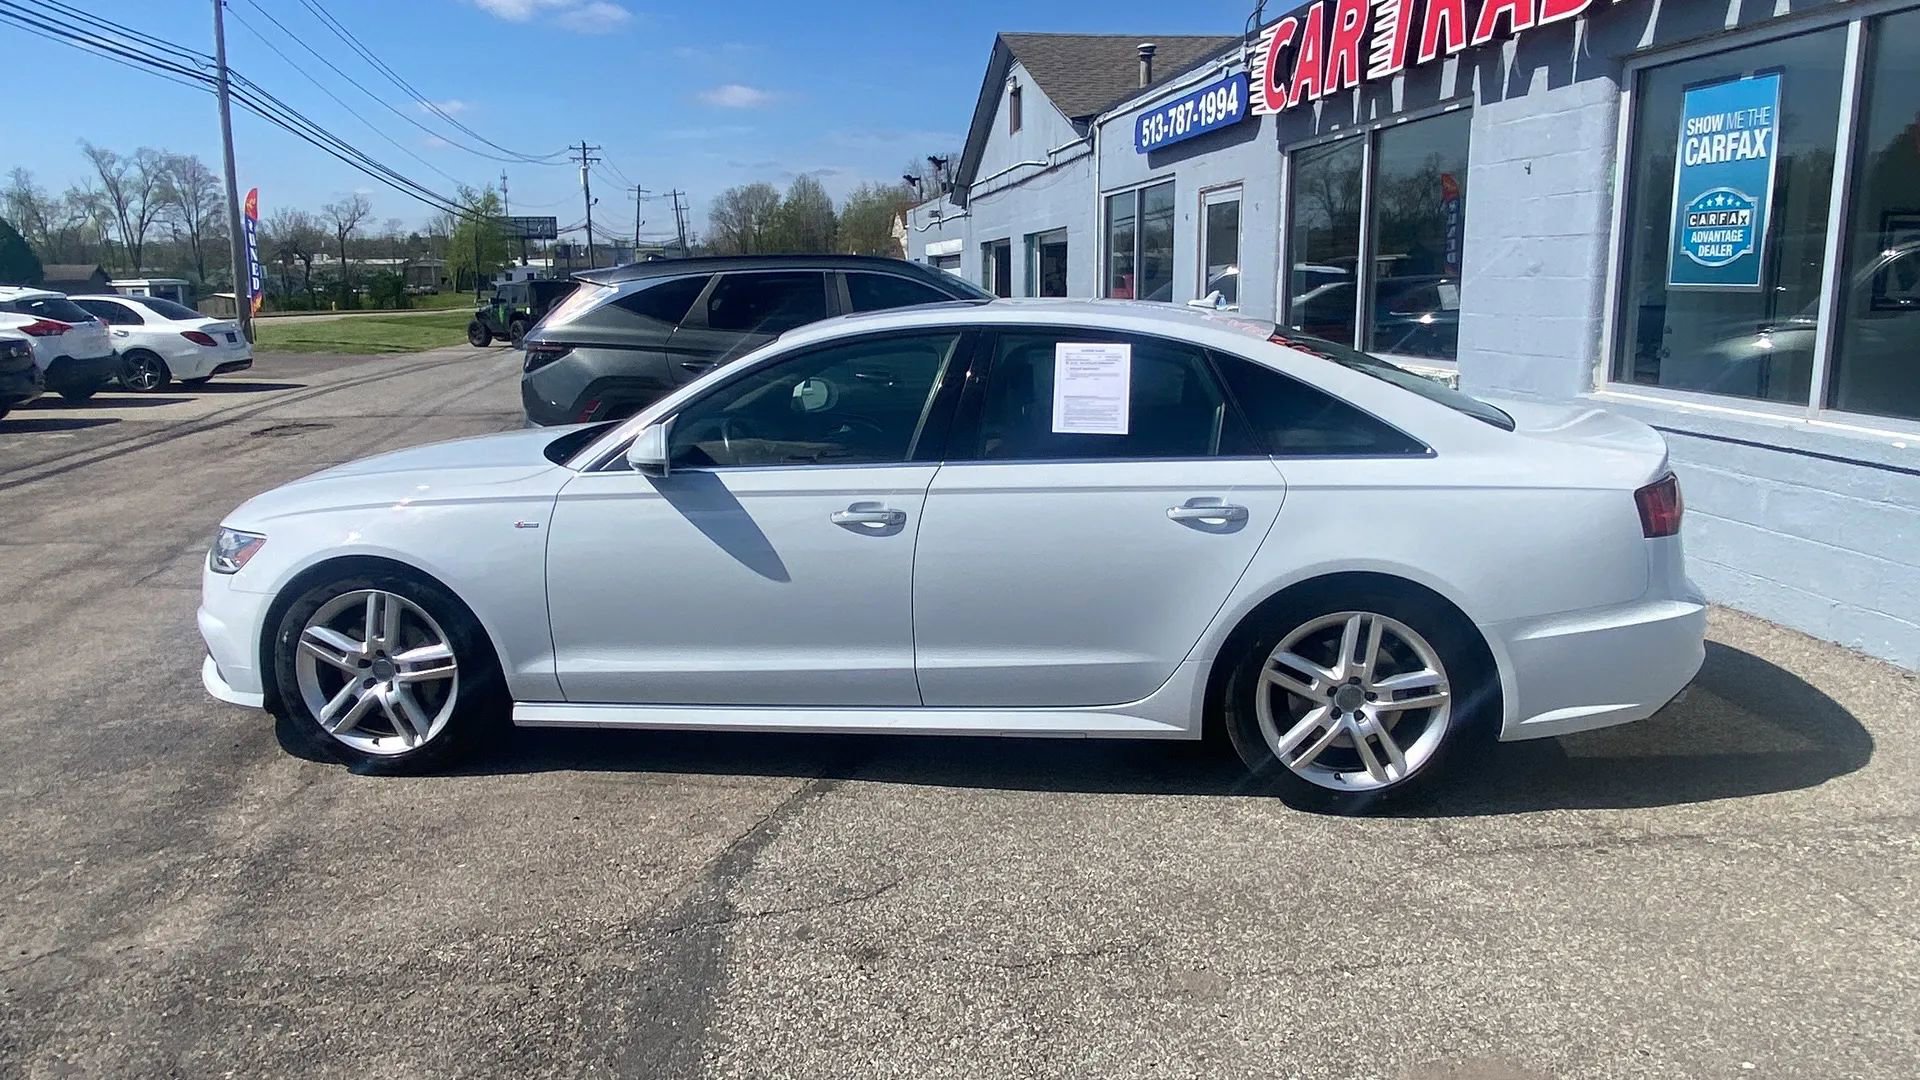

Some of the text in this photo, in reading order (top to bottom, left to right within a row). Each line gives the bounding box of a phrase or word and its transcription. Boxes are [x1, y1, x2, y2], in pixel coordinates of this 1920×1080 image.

[1259, 0, 1593, 114] CAR TR
[1141, 81, 1239, 148] 513-787-1994
[1686, 106, 1771, 136] SHOW ME THE
[1685, 128, 1769, 167] CARFAX
[1688, 211, 1749, 227] CARFAX
[1691, 230, 1744, 243] ADVANTAGE
[1698, 244, 1733, 257] DEALER
